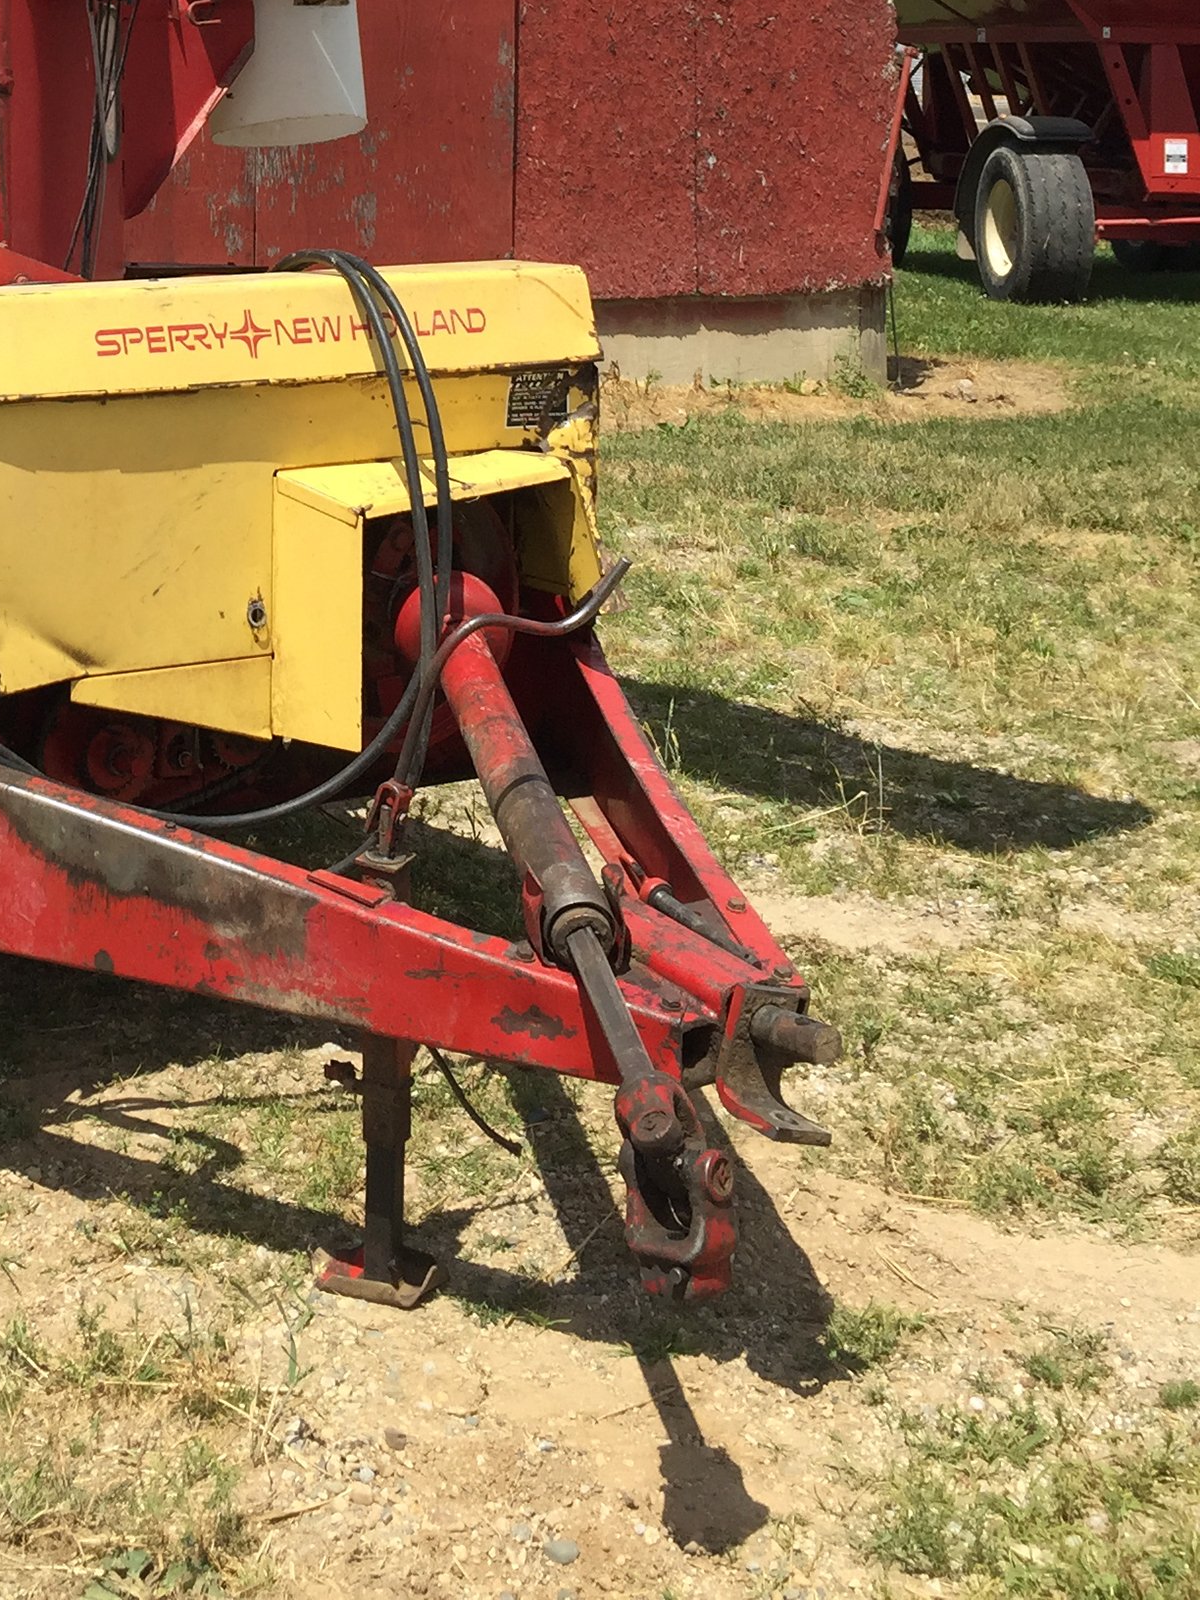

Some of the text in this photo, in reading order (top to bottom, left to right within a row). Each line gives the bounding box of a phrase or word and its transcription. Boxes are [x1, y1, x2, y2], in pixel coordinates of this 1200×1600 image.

[95, 307, 486, 357] SPERRY NEW HOLAND
[515, 372, 564, 382] ATTENTN
